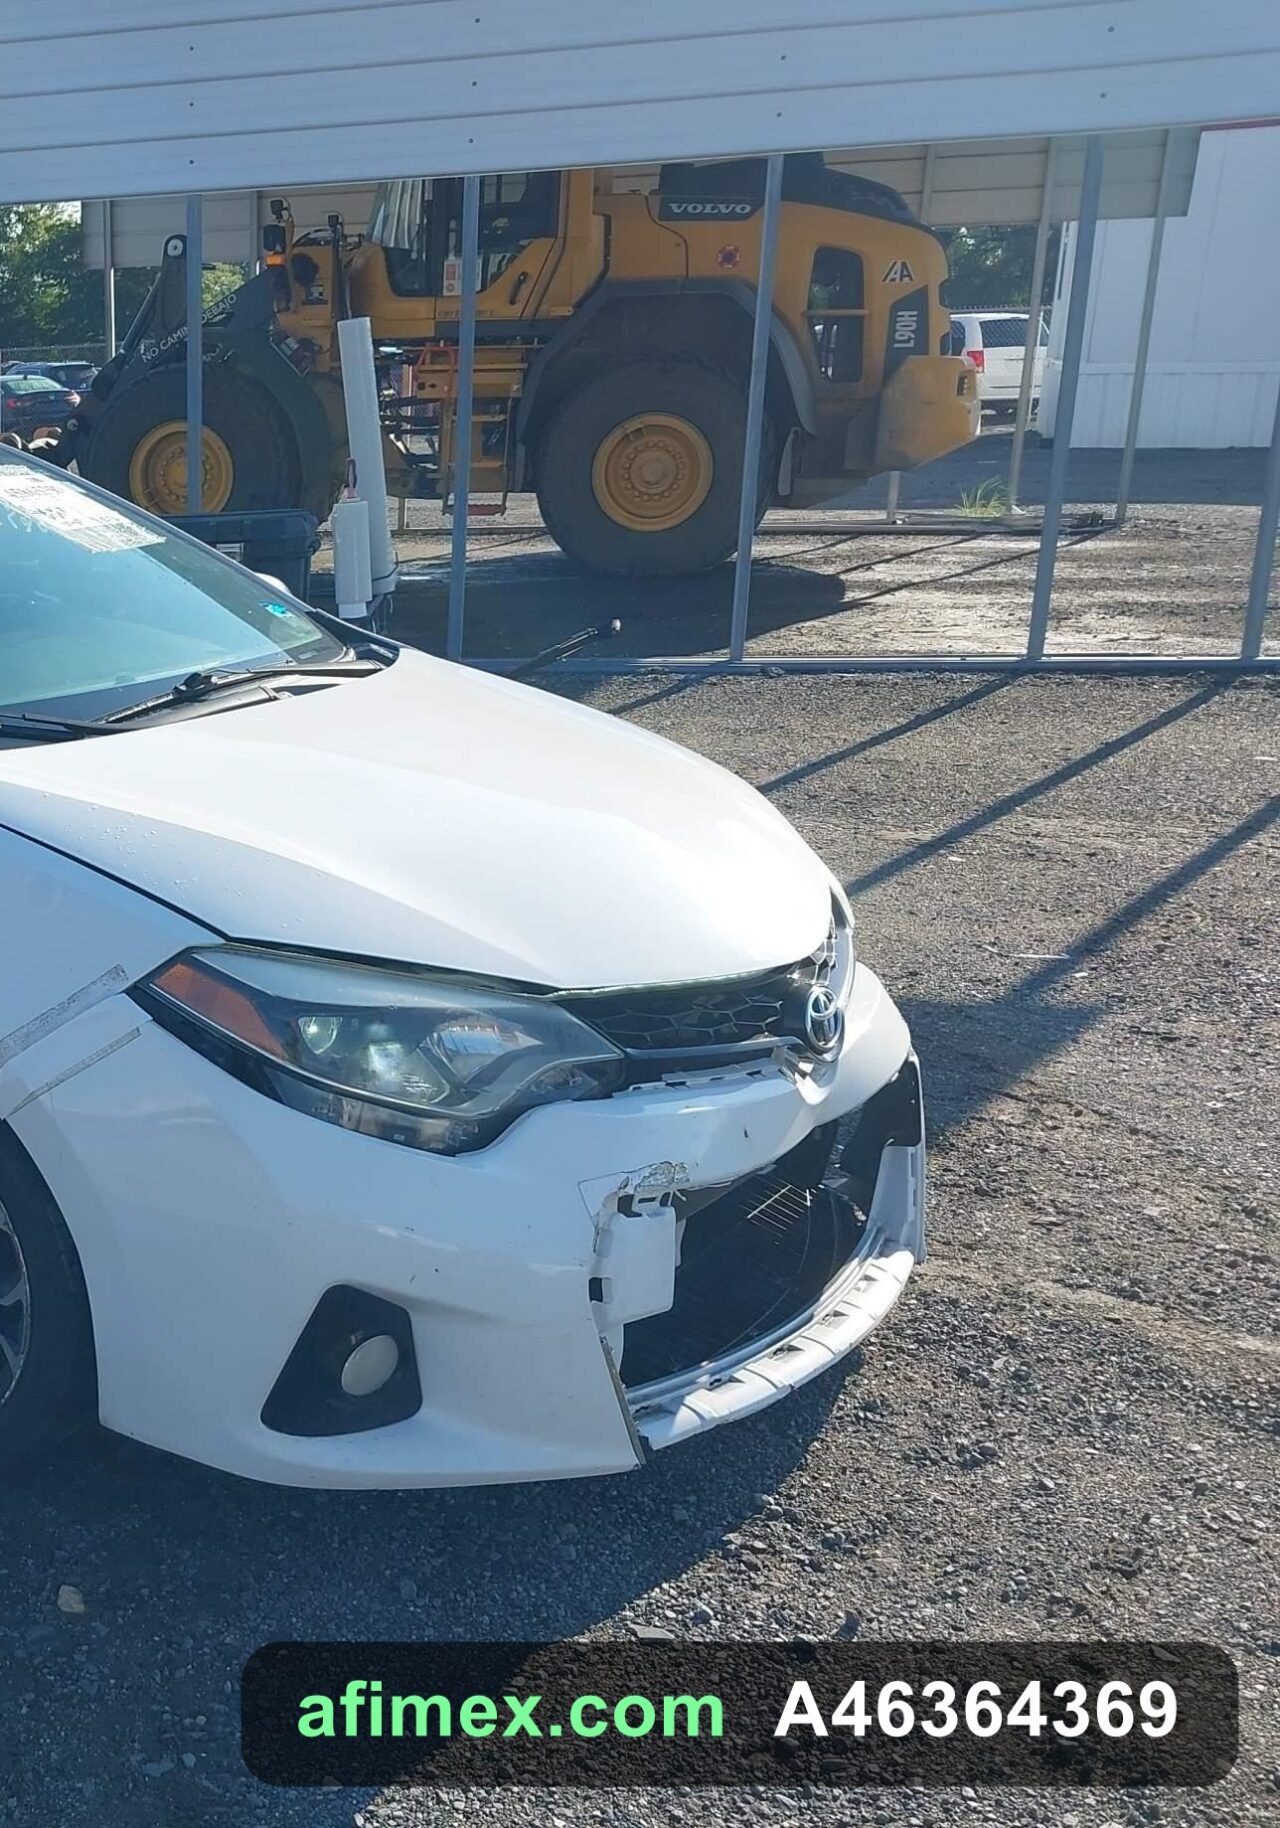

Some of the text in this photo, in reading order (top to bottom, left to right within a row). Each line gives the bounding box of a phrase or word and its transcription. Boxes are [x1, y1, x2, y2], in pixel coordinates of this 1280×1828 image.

[669, 203, 752, 214] VOLVO
[893, 310, 918, 348] L90H
[141, 347, 159, 362] NO
